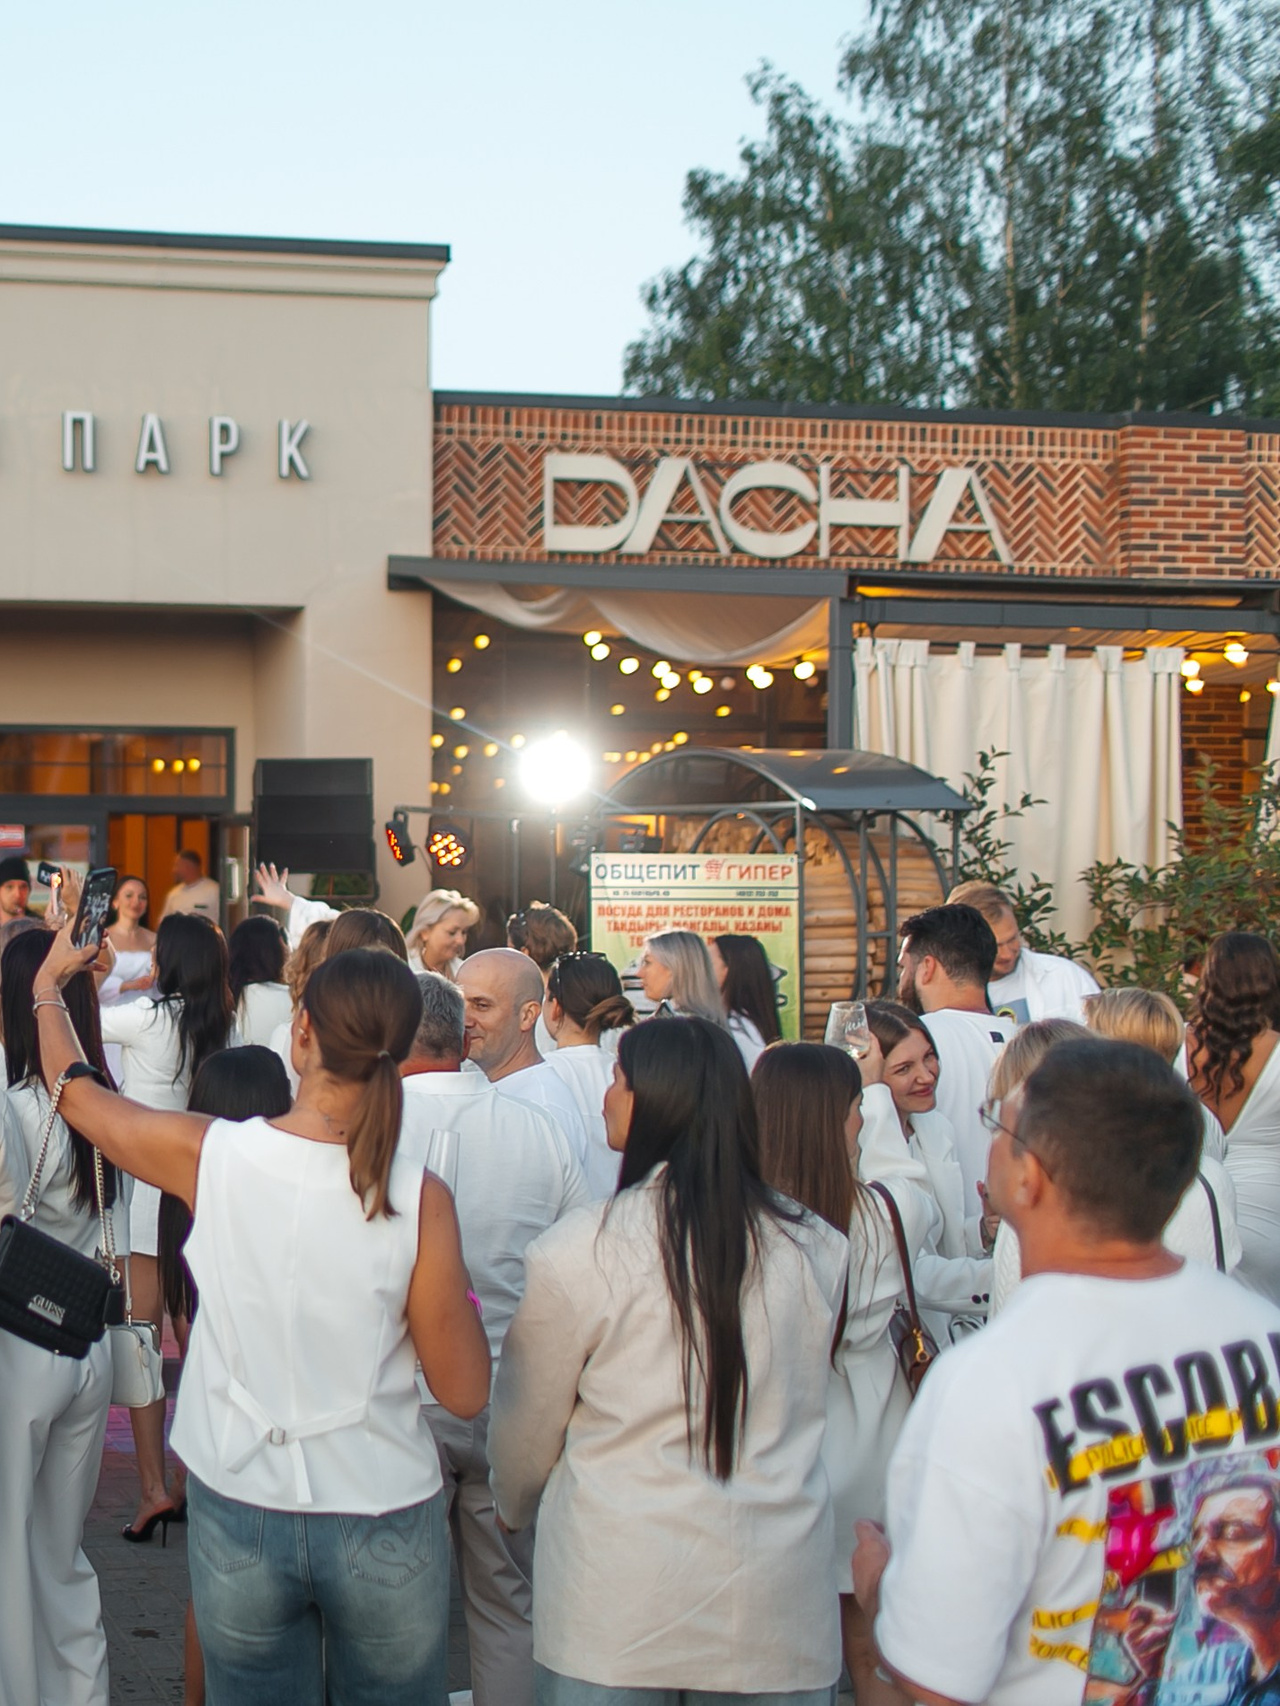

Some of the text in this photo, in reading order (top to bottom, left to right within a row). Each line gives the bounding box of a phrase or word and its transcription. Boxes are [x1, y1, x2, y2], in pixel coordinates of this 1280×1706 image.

[61, 409, 312, 481] ПАРК
[543, 452, 1013, 564] DACHA
[595, 863, 793, 883] ОБЩЕПИТ ГИПЕР
[597, 904, 792, 918] ПОСУДА ДЛЯ РЕСТОРАНОВ И ДОМА
[734, 920, 782, 933] КАЗАНЫ
[32, 1294, 66, 1319] GUESS
